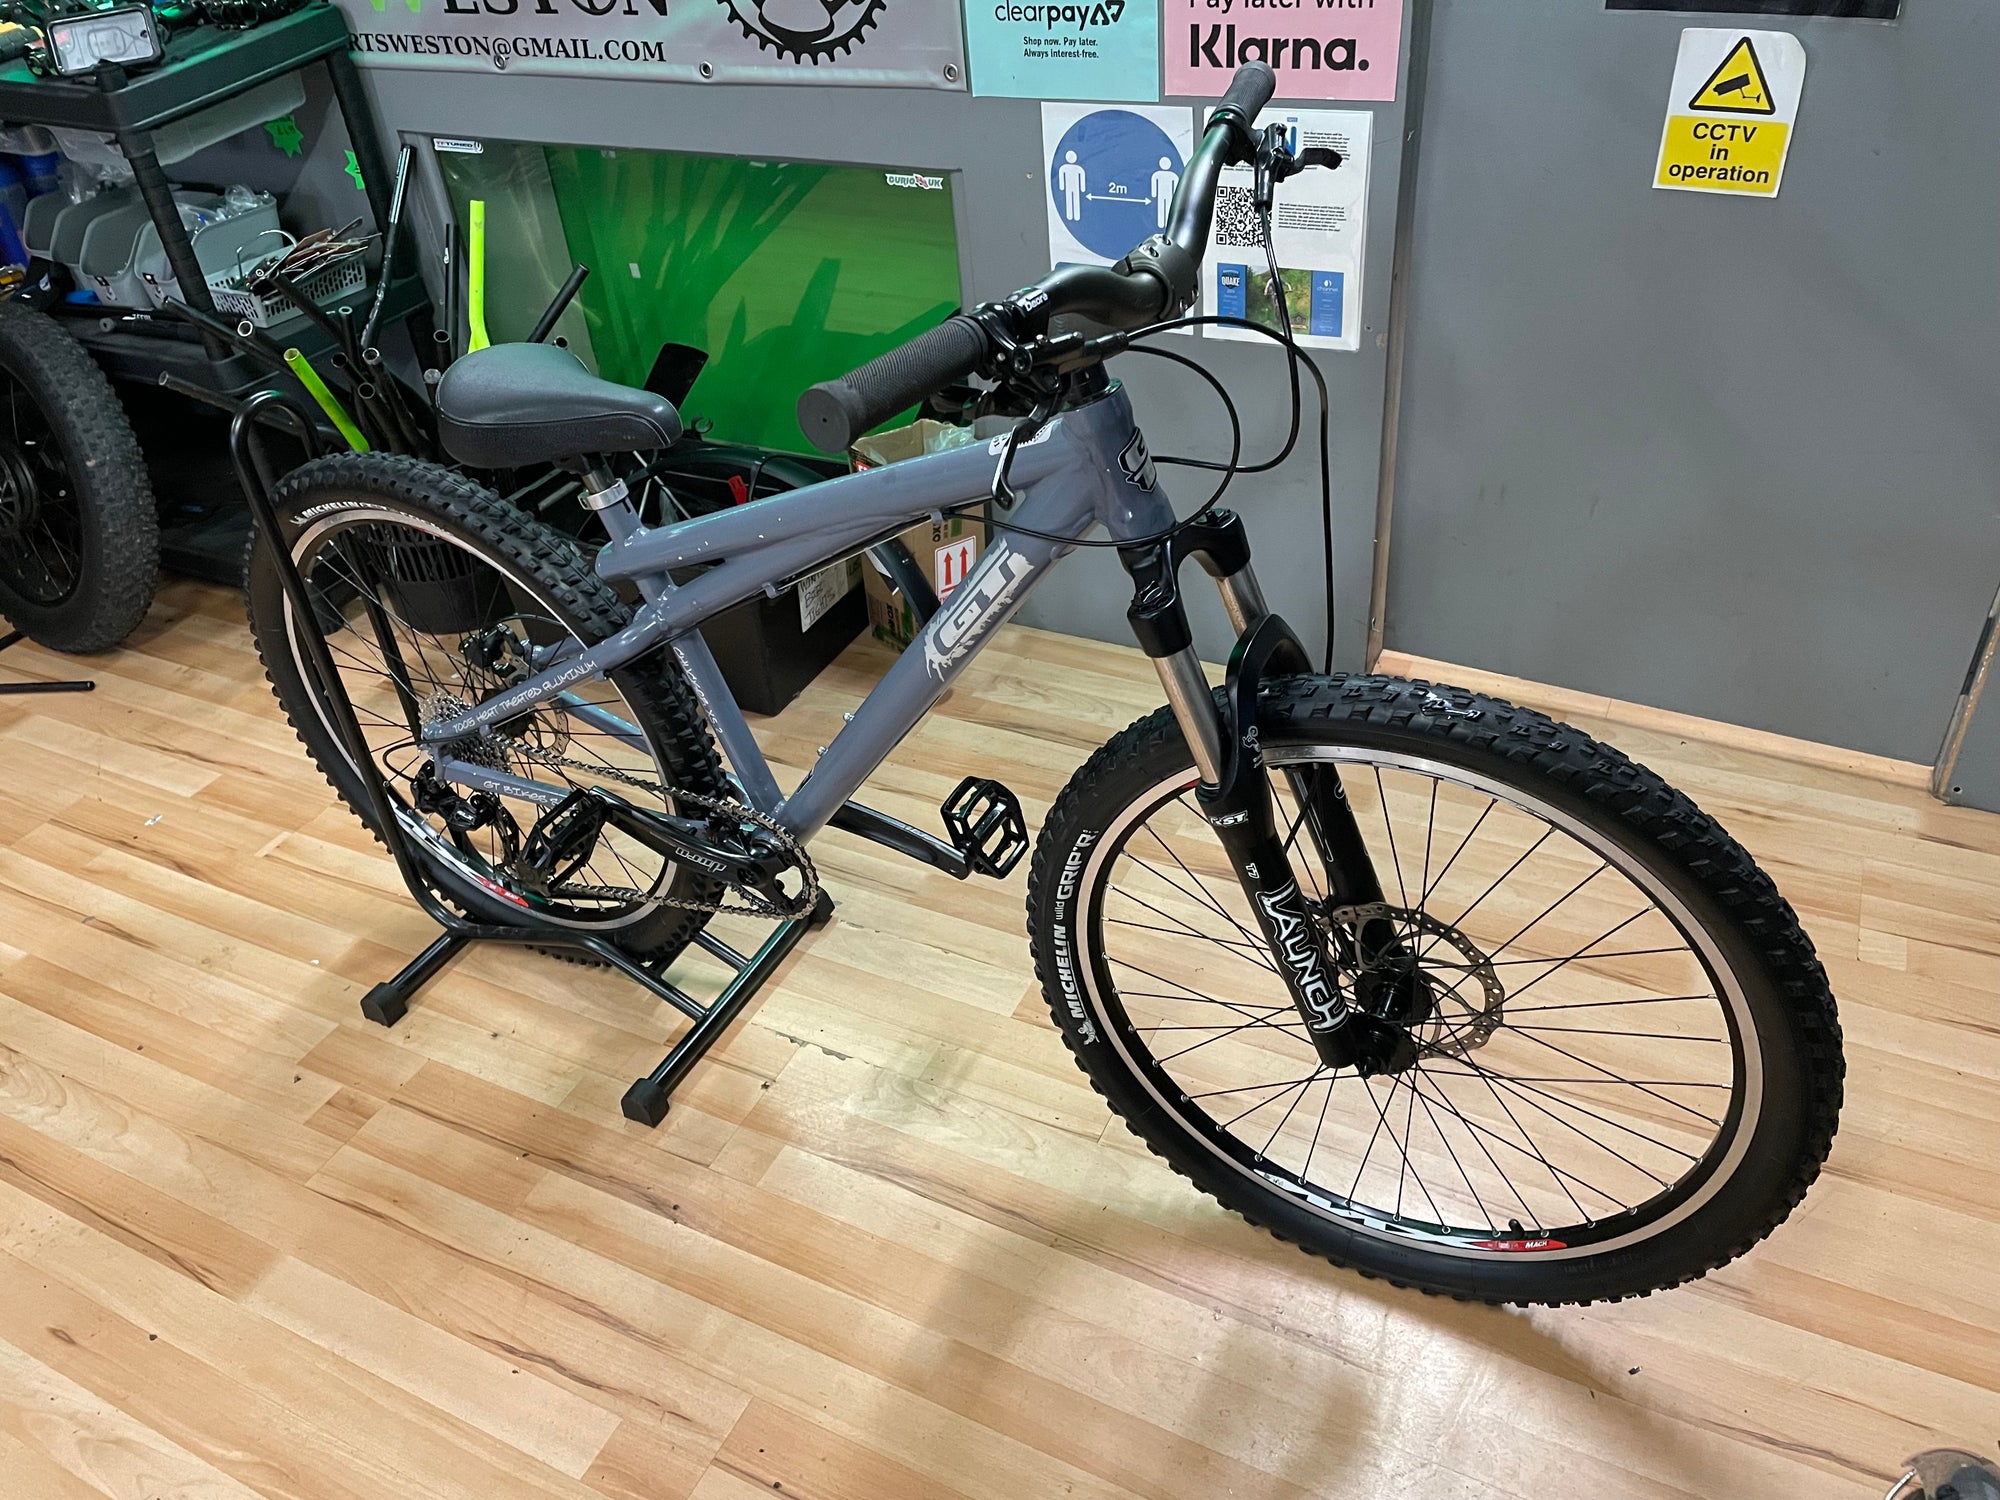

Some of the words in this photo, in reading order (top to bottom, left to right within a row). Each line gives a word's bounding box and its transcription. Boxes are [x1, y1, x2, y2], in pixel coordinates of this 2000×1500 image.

[994, 0, 1090, 31] clearpay
[1023, 36, 1042, 47] Shop
[1044, 38, 1061, 46] now.
[1063, 37, 1077, 46] Pay
[1079, 37, 1099, 46] later.
[1190, 24, 1370, 71] Klarna.
[1023, 48, 1049, 59] Always
[1050, 49, 1099, 58] interest-free.
[1693, 122, 1757, 142] CCTV
[1710, 144, 1729, 160] in
[1669, 164, 1769, 183] operation
[1108, 181, 1128, 194] 2m
[1221, 275, 1240, 287] QUAKE
[301, 501, 359, 519] MICHELIN
[932, 548, 1017, 657] GT
[483, 780, 501, 791] GT
[1056, 832, 1098, 900] GRIP'R
[1054, 900, 1065, 921] wild
[1257, 879, 1349, 1031] LAUNCH
[1053, 923, 1087, 1019] MICHELIN
[1524, 1239, 1548, 1249] MACH
